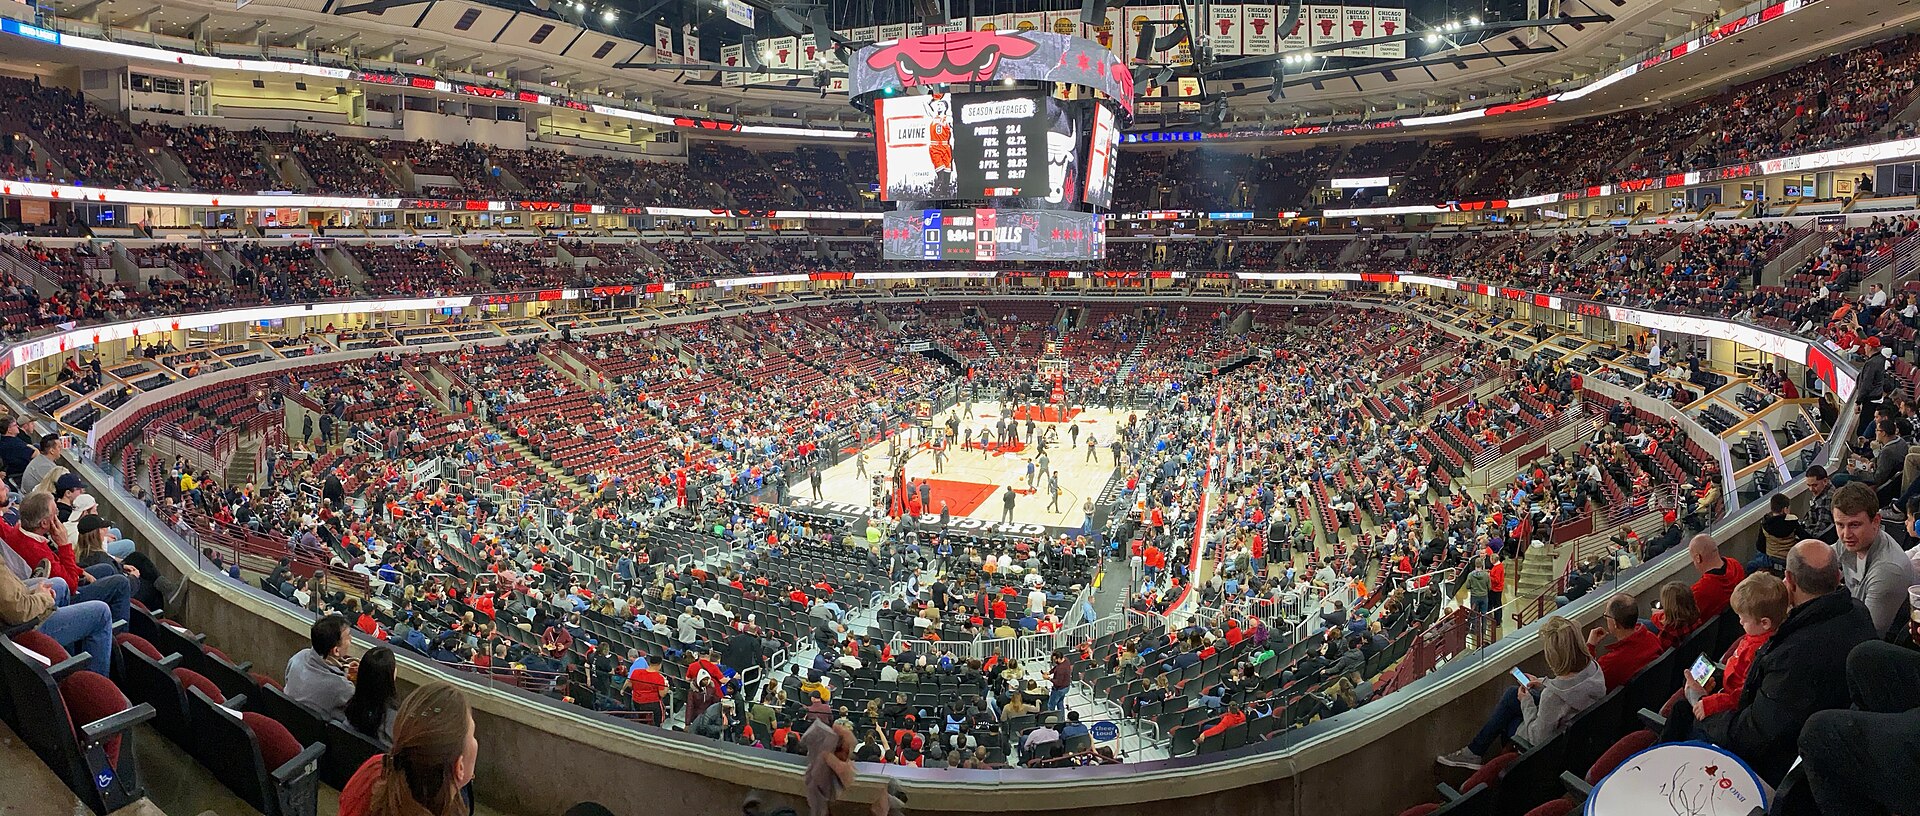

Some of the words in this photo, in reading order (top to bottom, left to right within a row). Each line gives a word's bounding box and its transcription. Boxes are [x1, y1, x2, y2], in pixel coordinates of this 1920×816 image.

[413, 76, 435, 89] CHICAGO
[834, 80, 842, 89] 72
[968, 107, 992, 116] SEASON
[995, 104, 1027, 114] AVERAGES
[898, 128, 925, 139] LAVINE
[974, 126, 999, 136] POINTS:
[1141, 132, 1202, 142] CENTER
[1006, 136, 1026, 145] 42.7%
[984, 149, 999, 157] FT%:
[1766, 159, 1782, 173] INSPIRE
[1783, 158, 1793, 171] WITH
[1793, 157, 1800, 169] US
[995, 227, 1022, 242] ULLS
[918, 514, 1046, 534] CHICAG
[1114, 587, 1130, 612] UNITED
[1729, 787, 1746, 803] BMO
